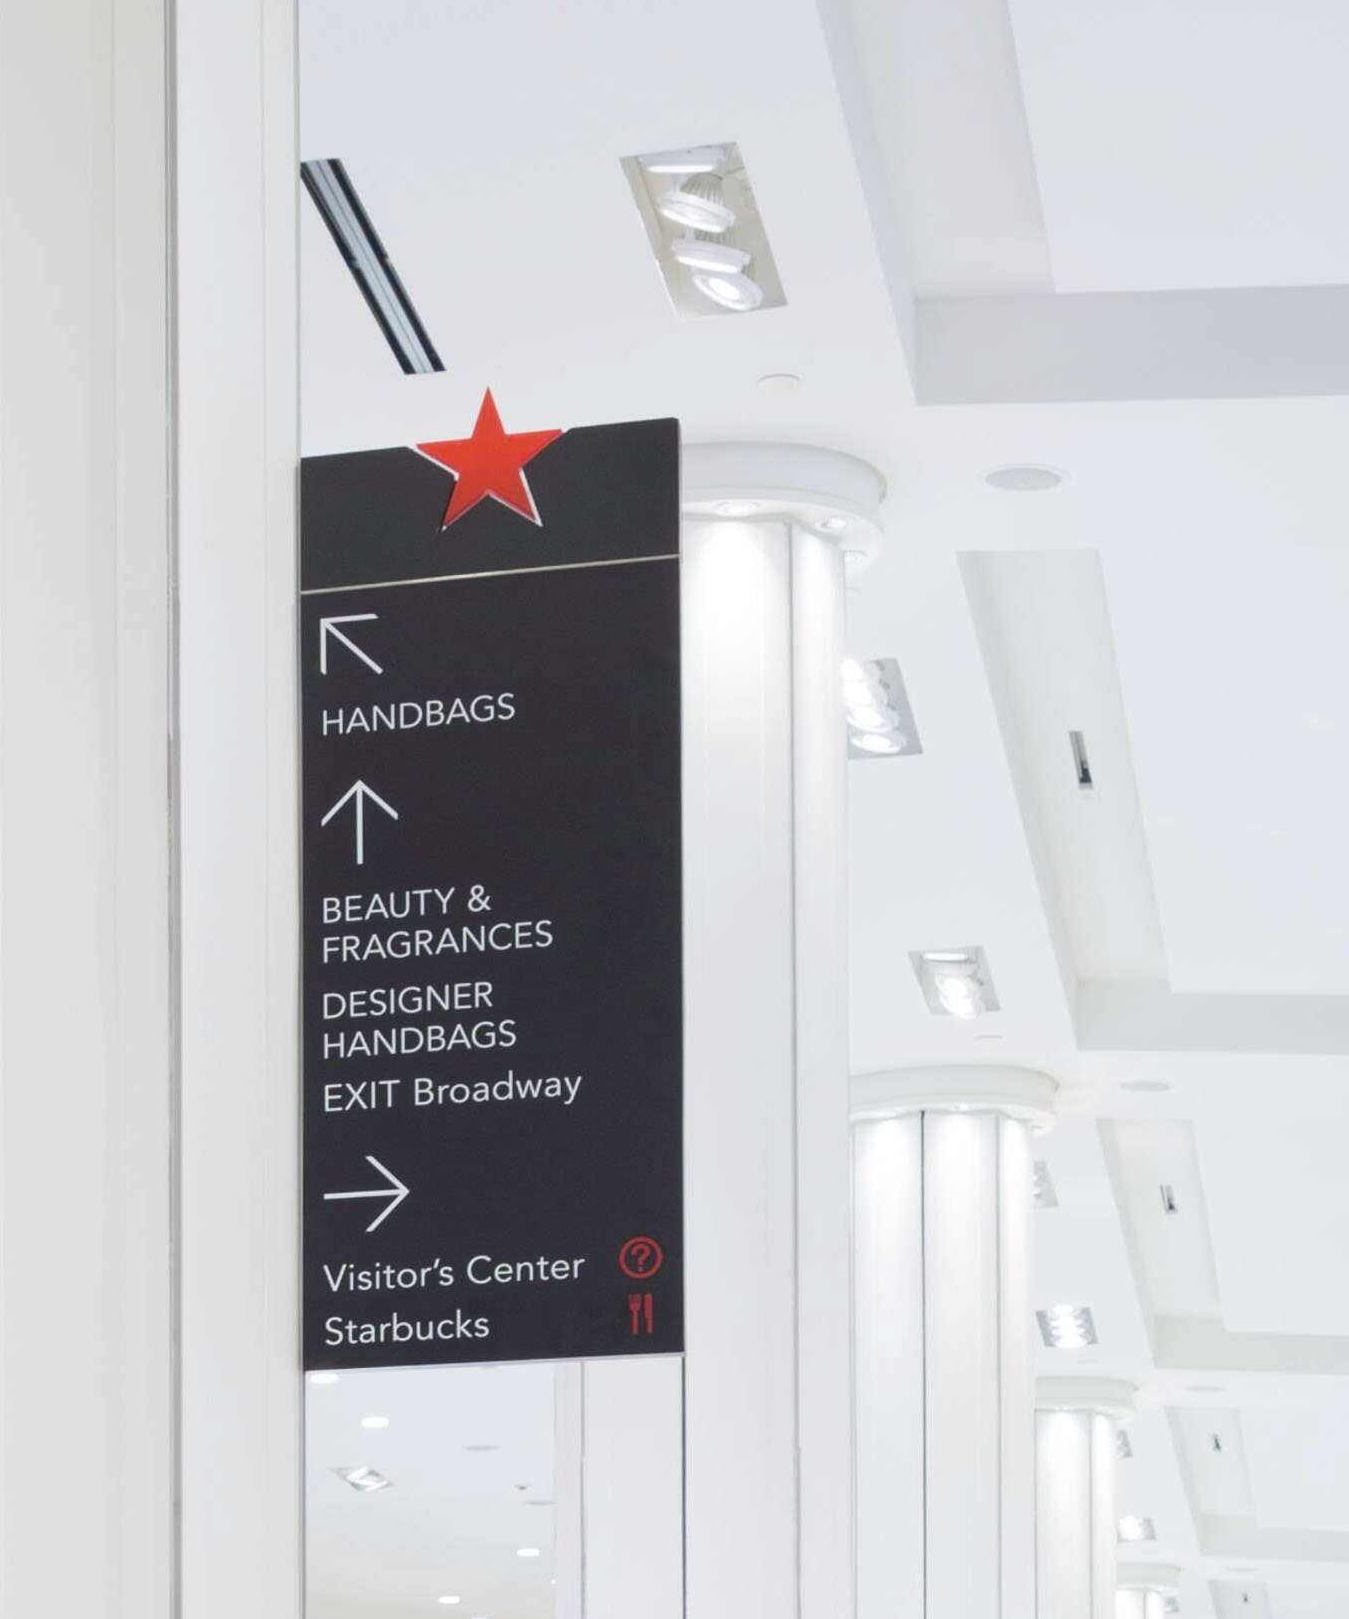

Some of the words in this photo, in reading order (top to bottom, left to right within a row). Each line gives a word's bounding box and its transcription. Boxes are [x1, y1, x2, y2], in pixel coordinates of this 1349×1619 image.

[322, 692, 516, 737] HANDBAGS
[322, 886, 456, 924] BEAUTY
[467, 884, 492, 913] &
[323, 919, 554, 964] FRAGRANCES
[323, 981, 493, 1020] DESIGNER
[323, 1019, 517, 1060] HANDBAGS
[324, 1079, 401, 1113] EXIT
[414, 1069, 582, 1106] Broadway
[323, 1257, 454, 1293] Visitor's
[466, 1254, 586, 1285] Center
[325, 1308, 490, 1346] Starbucks
